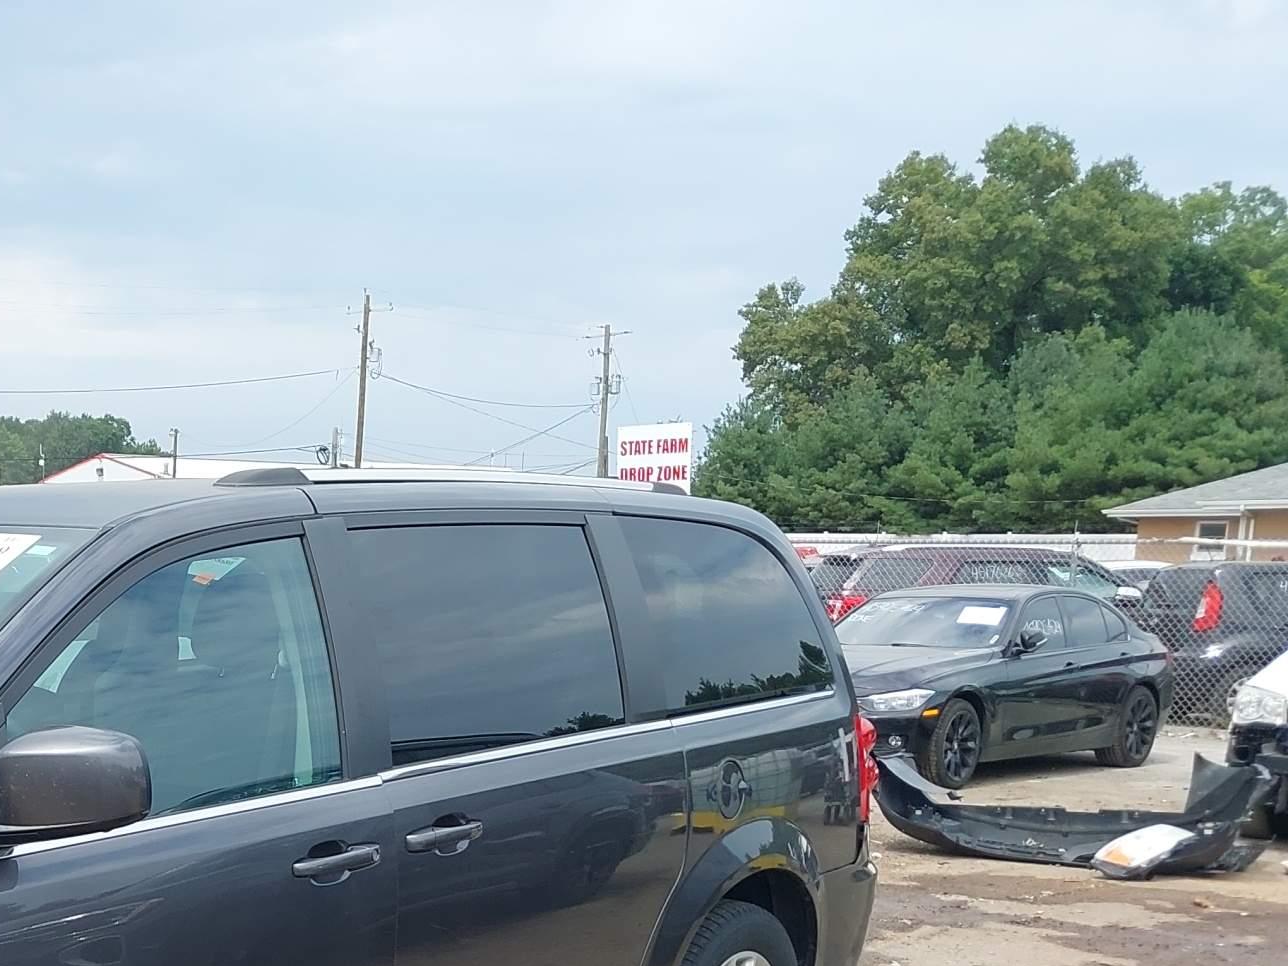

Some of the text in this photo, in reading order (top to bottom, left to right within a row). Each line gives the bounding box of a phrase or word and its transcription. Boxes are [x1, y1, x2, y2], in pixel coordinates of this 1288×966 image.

[620, 438, 689, 456] STATE FARM
[620, 465, 688, 482] DROP ZONE
